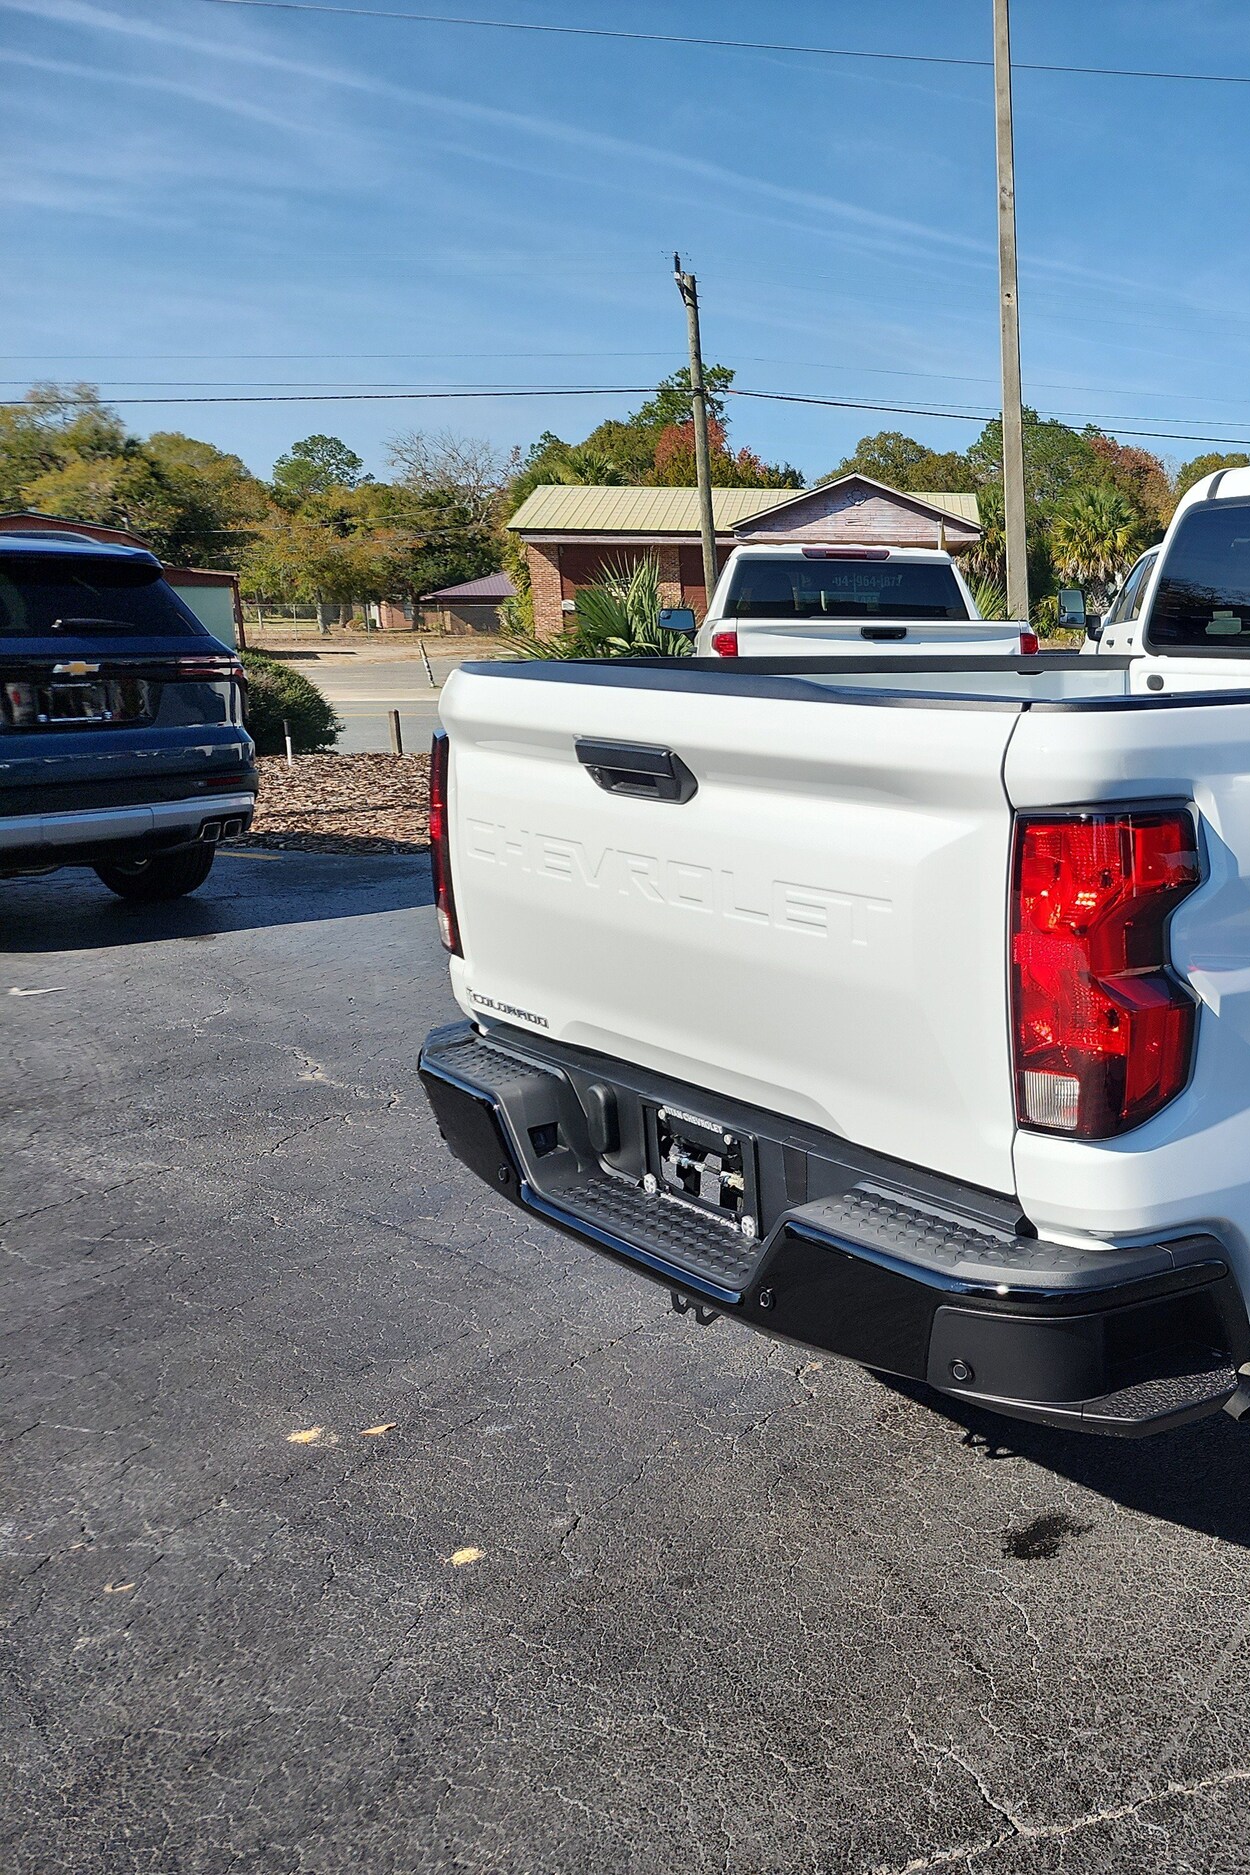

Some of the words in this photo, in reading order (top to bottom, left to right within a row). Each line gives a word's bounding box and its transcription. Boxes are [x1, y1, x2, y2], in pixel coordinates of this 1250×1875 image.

[466, 817, 893, 945] CHEVROLET
[472, 993, 549, 1029] COLORADO
[683, 1112, 723, 1134] CHEVROLET
